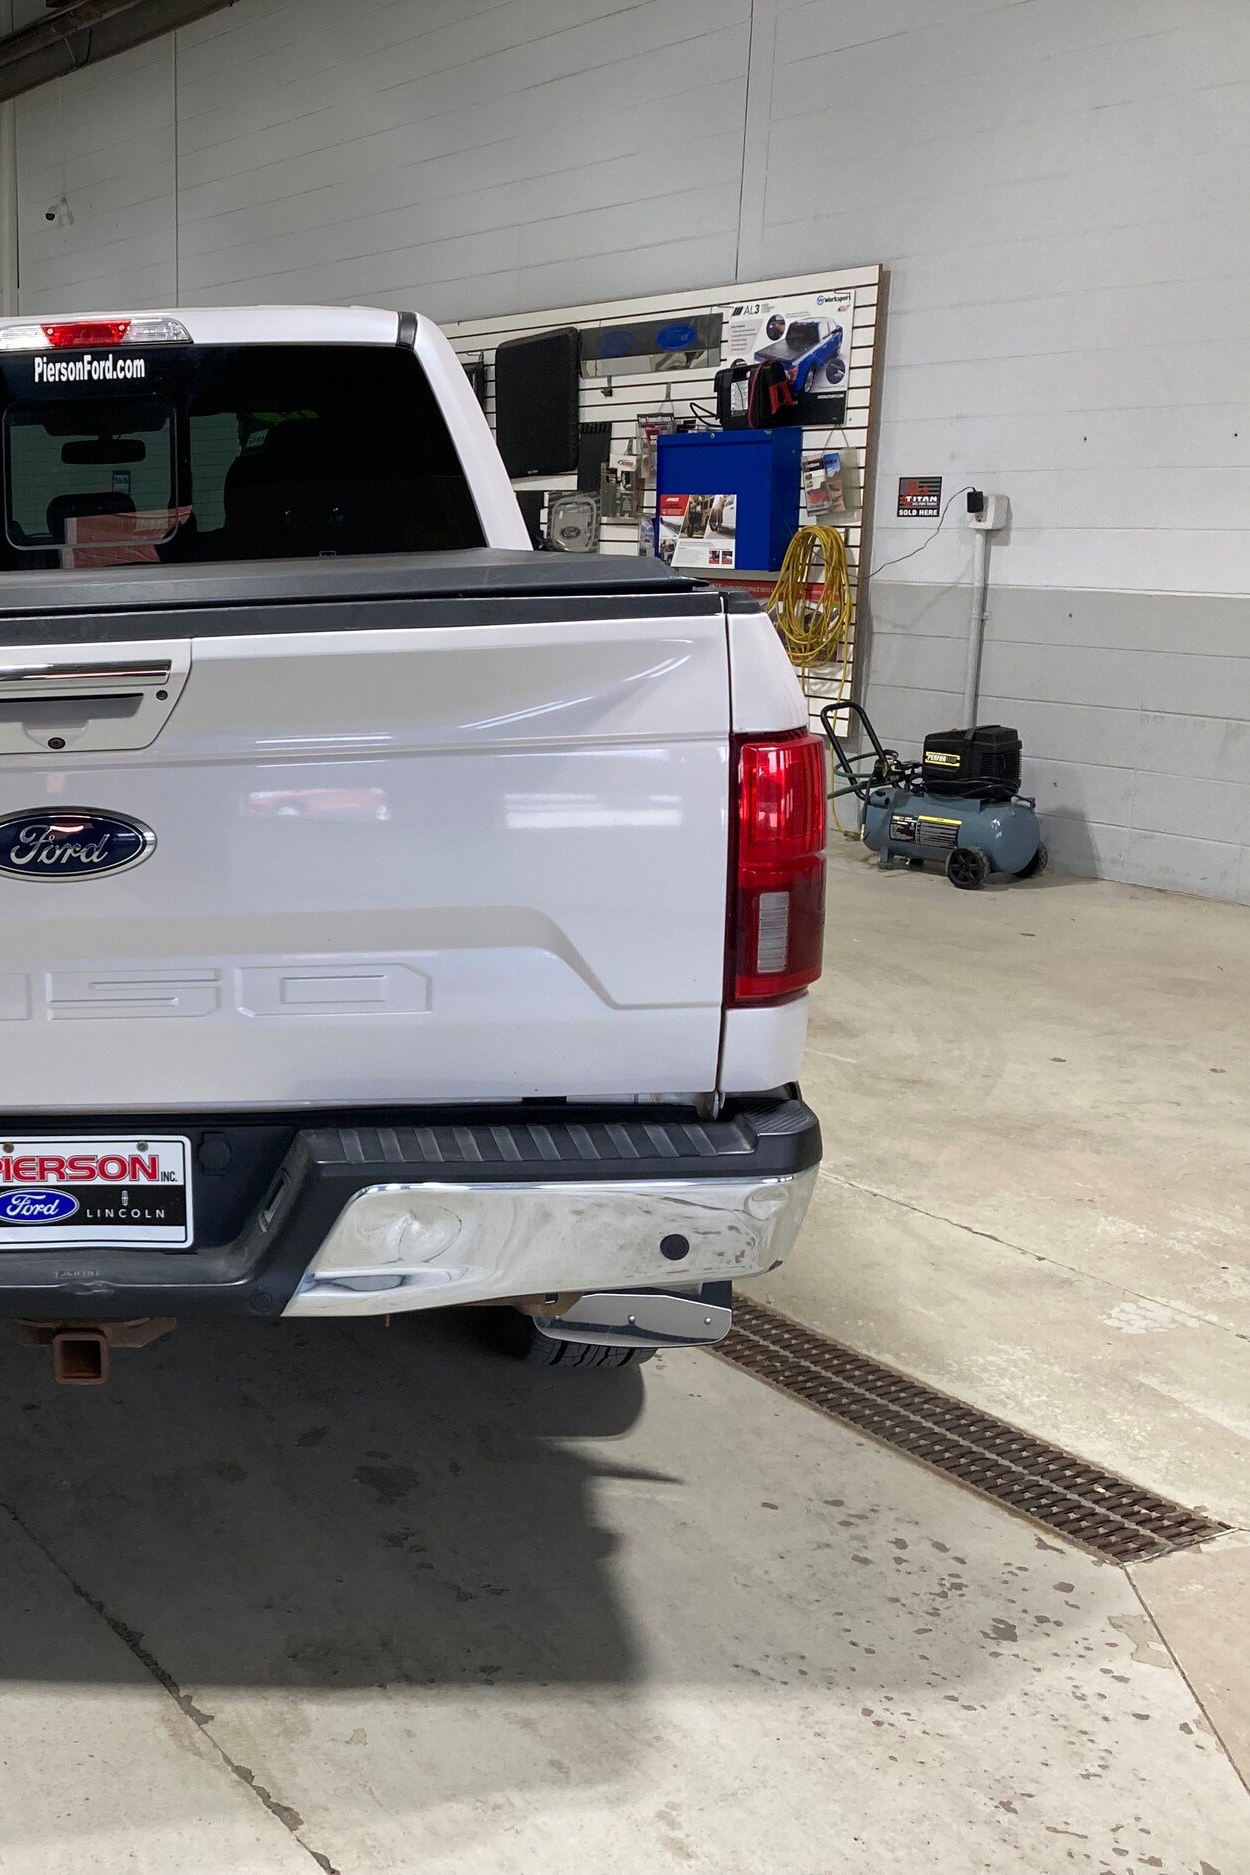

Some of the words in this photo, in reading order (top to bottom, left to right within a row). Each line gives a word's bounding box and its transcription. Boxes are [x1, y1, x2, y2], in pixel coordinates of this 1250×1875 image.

[824, 295, 852, 304] Worksport
[743, 304, 760, 316] AL3
[34, 353, 146, 383] PiersonFord.com
[905, 495, 938, 503] TITAN
[10, 824, 110, 865] Ford
[161, 1171, 178, 1182] INC.
[6, 1194, 60, 1217] Ford
[86, 1208, 166, 1219] LINCOLN
